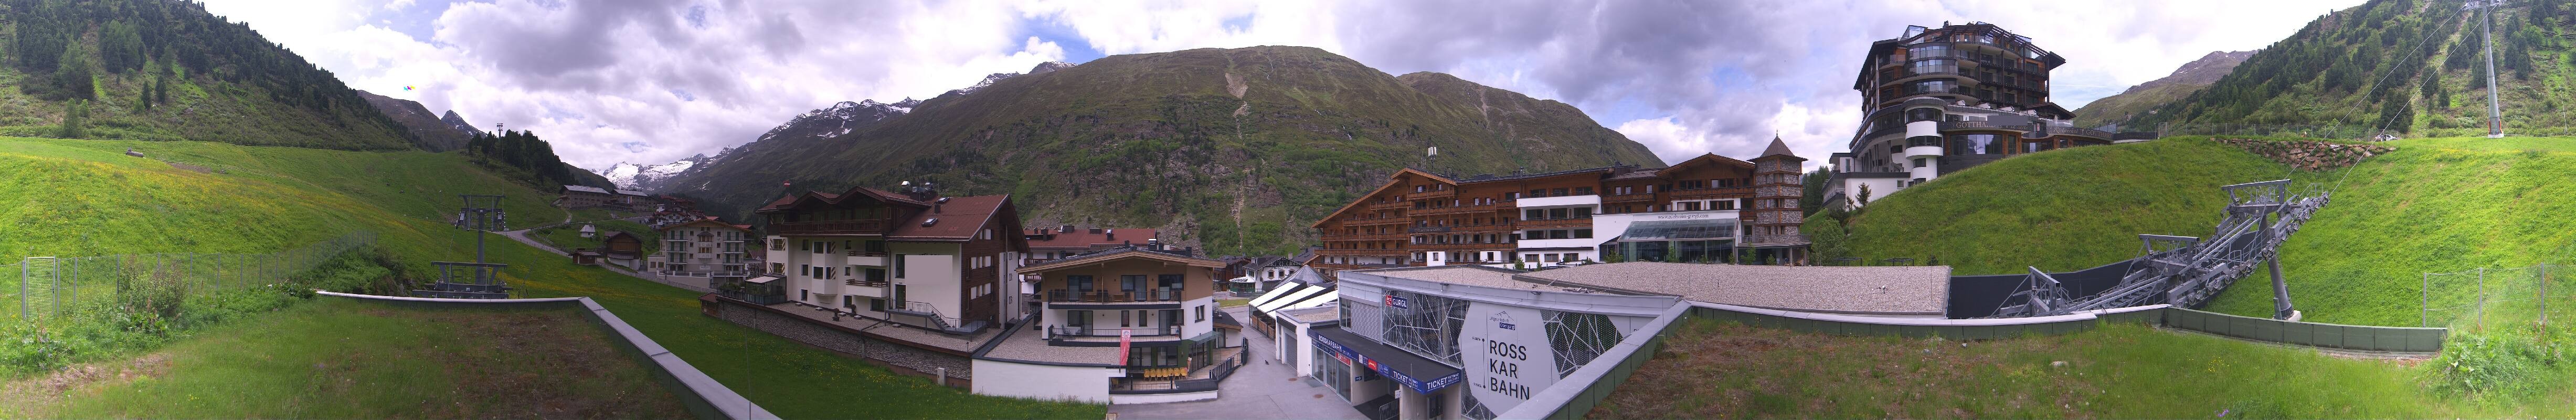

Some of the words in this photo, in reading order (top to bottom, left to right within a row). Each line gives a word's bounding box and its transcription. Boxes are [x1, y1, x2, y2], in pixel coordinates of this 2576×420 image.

[1392, 298, 1407, 307] GURGL
[1319, 334, 1342, 352] ROSSKARBAHN
[1490, 340, 1526, 361] ROSS
[1393, 371, 1408, 383] TICKET
[1490, 358, 1518, 379] KAR
[1427, 376, 1448, 390] TICKET
[1490, 376, 1530, 401] BAHN
